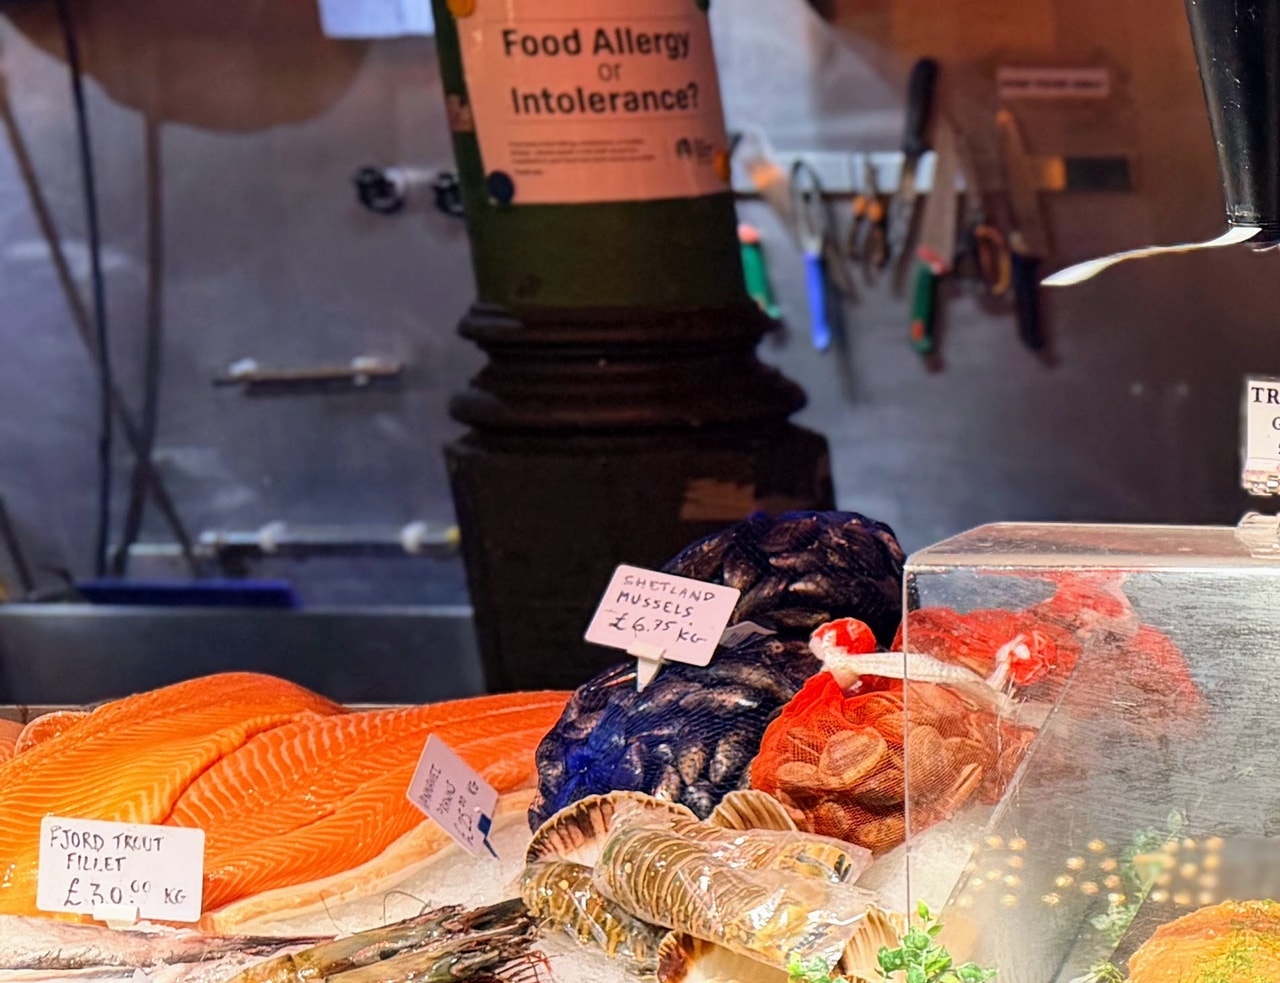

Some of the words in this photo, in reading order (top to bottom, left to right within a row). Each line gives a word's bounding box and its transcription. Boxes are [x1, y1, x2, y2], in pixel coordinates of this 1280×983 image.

[502, 28, 582, 57] Food
[592, 27, 691, 60] Allergy
[597, 62, 623, 82] or
[511, 82, 700, 115] Intolerance?
[623, 575, 716, 602] SHETLAND
[616, 591, 695, 618] MUSSELS
[50, 825, 104, 852] FJORD
[112, 832, 165, 853] TROUT
[66, 854, 127, 872] FILLET
